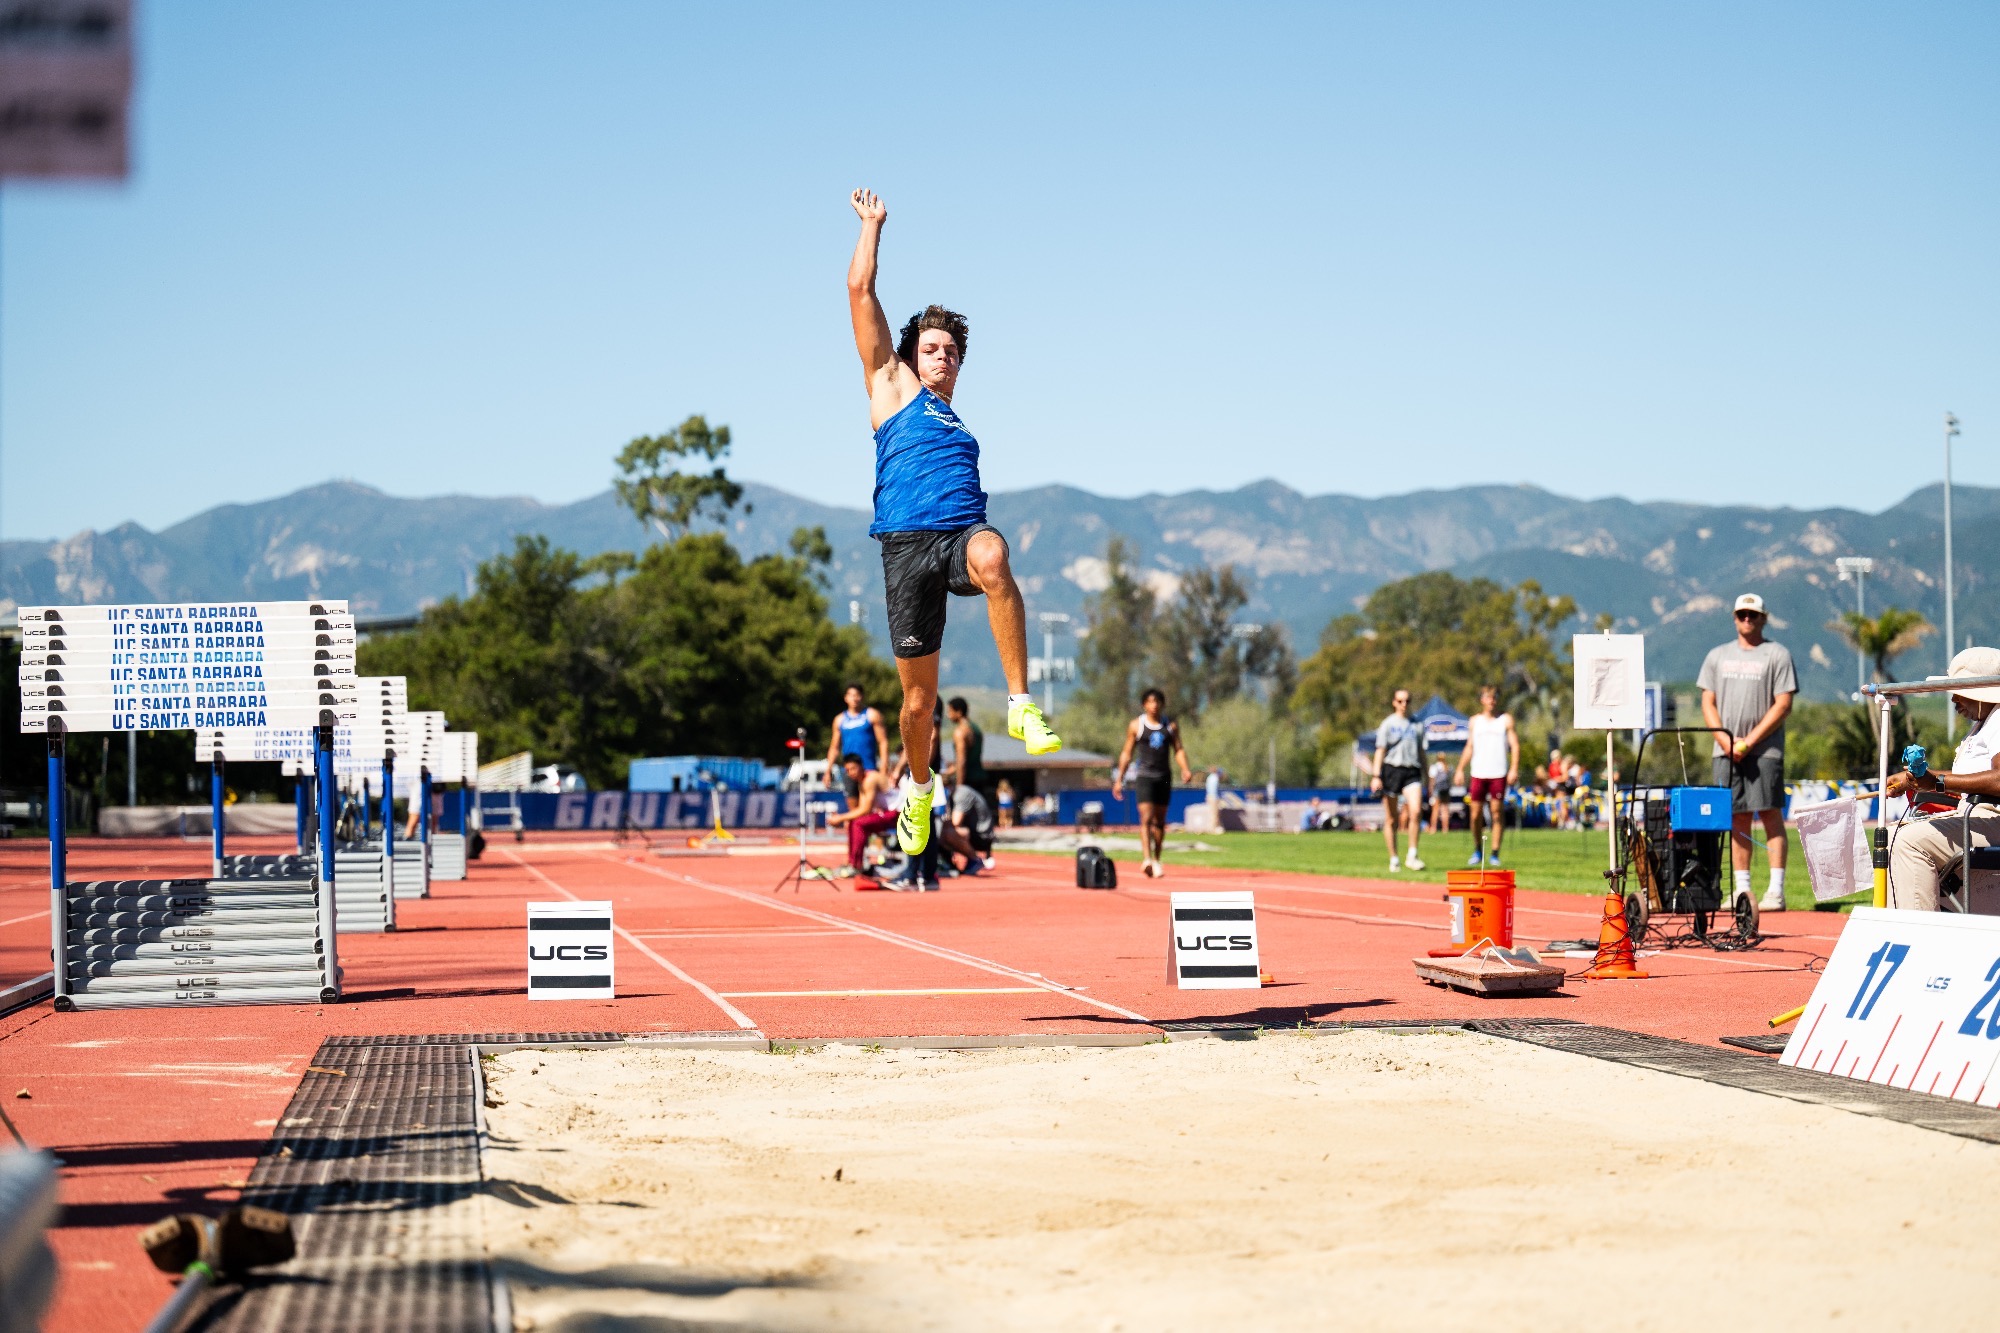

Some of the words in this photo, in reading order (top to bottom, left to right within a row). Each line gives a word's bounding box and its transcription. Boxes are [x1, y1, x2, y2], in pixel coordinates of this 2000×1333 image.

[112, 713, 135, 729] UC
[140, 712, 190, 729] SANTA
[195, 710, 267, 727] BARBARA
[272, 749, 304, 759] SANTA
[554, 791, 812, 829] GAUCHOS
[173, 897, 214, 907] UCS
[172, 928, 215, 937] UCS
[1177, 935, 1253, 951] UCS
[529, 945, 608, 961] UCS
[176, 977, 220, 987] UCS
[1846, 941, 1911, 1021] 17
[1926, 976, 1952, 990] UCS
[175, 991, 217, 999] UCS
